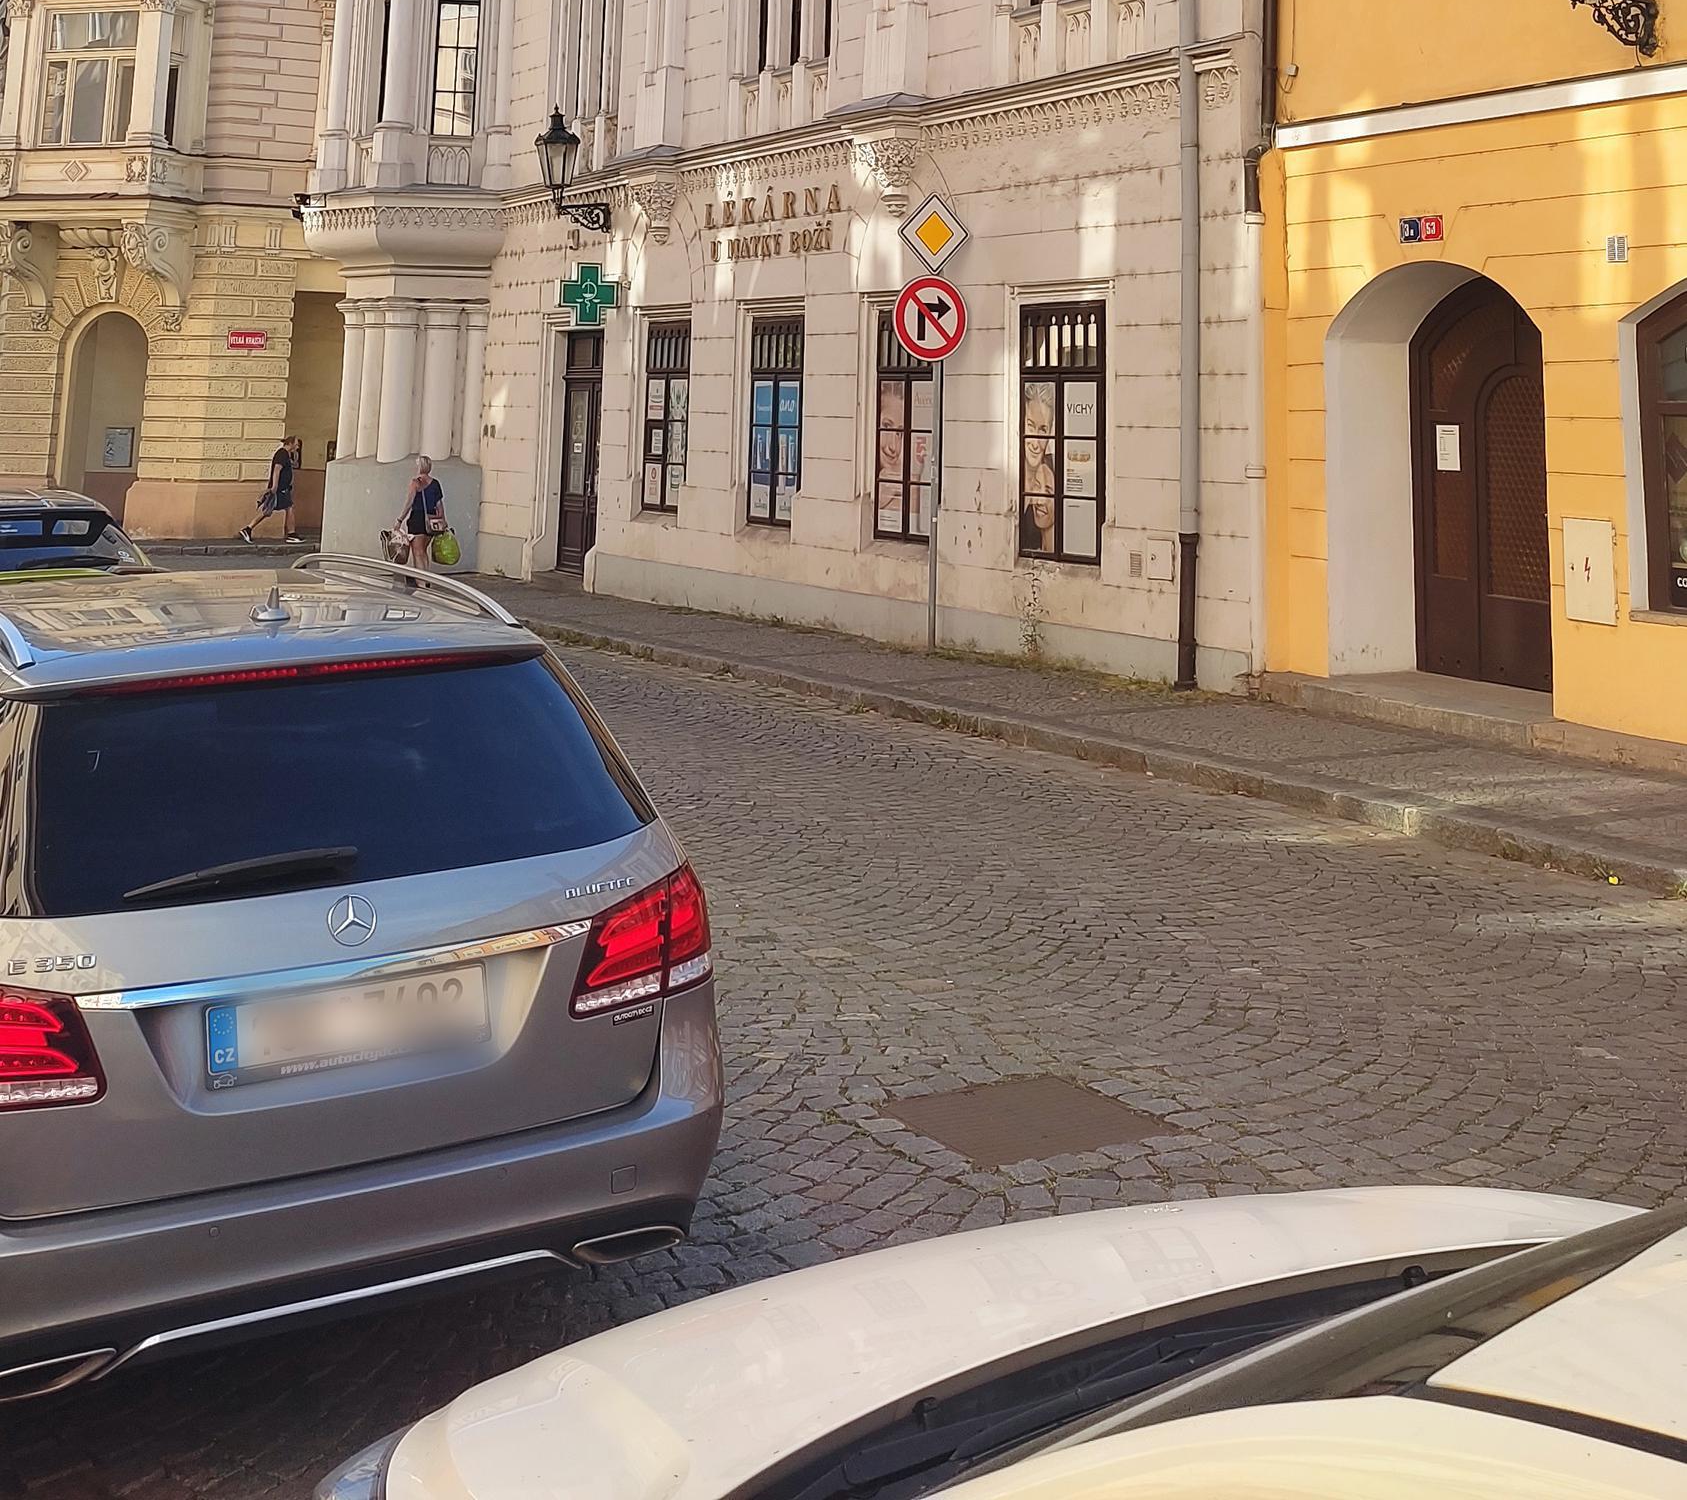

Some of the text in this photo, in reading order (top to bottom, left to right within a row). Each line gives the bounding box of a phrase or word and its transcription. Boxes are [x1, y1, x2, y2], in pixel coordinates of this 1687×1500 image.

[704, 183, 842, 229] LÉKÁRNA
[1426, 221, 1436, 235] 53
[710, 220, 833, 262] U MATKY BOŽÍ
[1066, 403, 1094, 415] VICHY
[565, 876, 635, 899] BLUETEC
[8, 954, 97, 976] E 350
[214, 1047, 235, 1064] CZ
